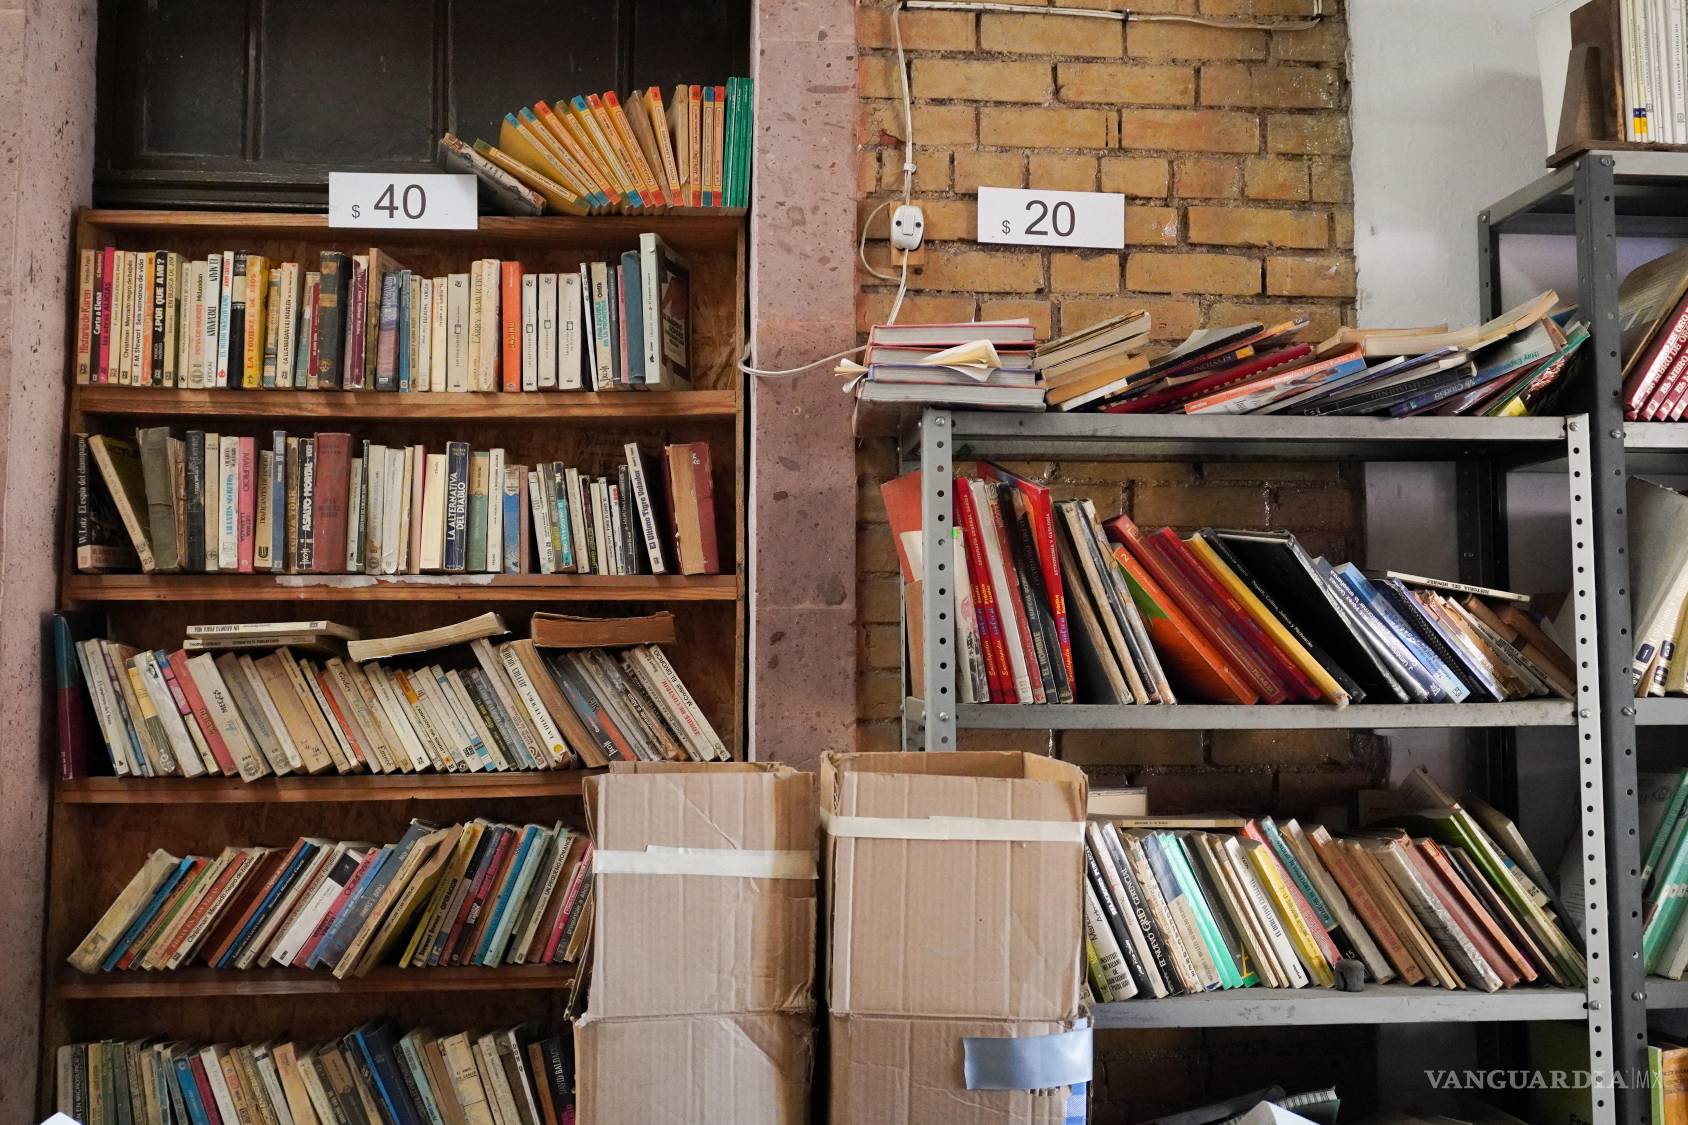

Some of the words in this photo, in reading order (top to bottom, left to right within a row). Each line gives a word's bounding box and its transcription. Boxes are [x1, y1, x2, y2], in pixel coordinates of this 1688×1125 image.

[351, 204, 360, 219] $
[373, 183, 426, 219] 40
[1001, 219, 1010, 235] $
[1024, 200, 1075, 237] 20
[80, 288, 91, 313] Karen
[154, 307, 164, 332] ¿POR
[471, 318, 481, 343] LARRY
[1673, 312, 1688, 333] ORO
[79, 320, 89, 353] Historia
[1669, 341, 1682, 356] DE
[302, 460, 313, 496] MORTAL
[633, 469, 646, 496] Volador
[448, 471, 458, 526] ALTERNATIVA
[456, 481, 466, 512] DIABLO
[638, 496, 651, 516] Tigre
[301, 498, 312, 530] ASALTO
[446, 529, 456, 539] LA
[1121, 552, 1130, 564] 2
[1032, 630, 1048, 665] HOMBRE
[1040, 665, 1050, 676] EL
[207, 891, 229, 917] Mercado
[225, 878, 240, 895] negro
[235, 870, 245, 881] de
[1095, 876, 1117, 915] RELACIONES
[1119, 866, 1141, 905] GERENCIAL
[1133, 906, 1153, 932] GRID
[1146, 931, 1162, 956] NUEVO
[1273, 928, 1282, 938] EL
[1155, 954, 1167, 966] EL
